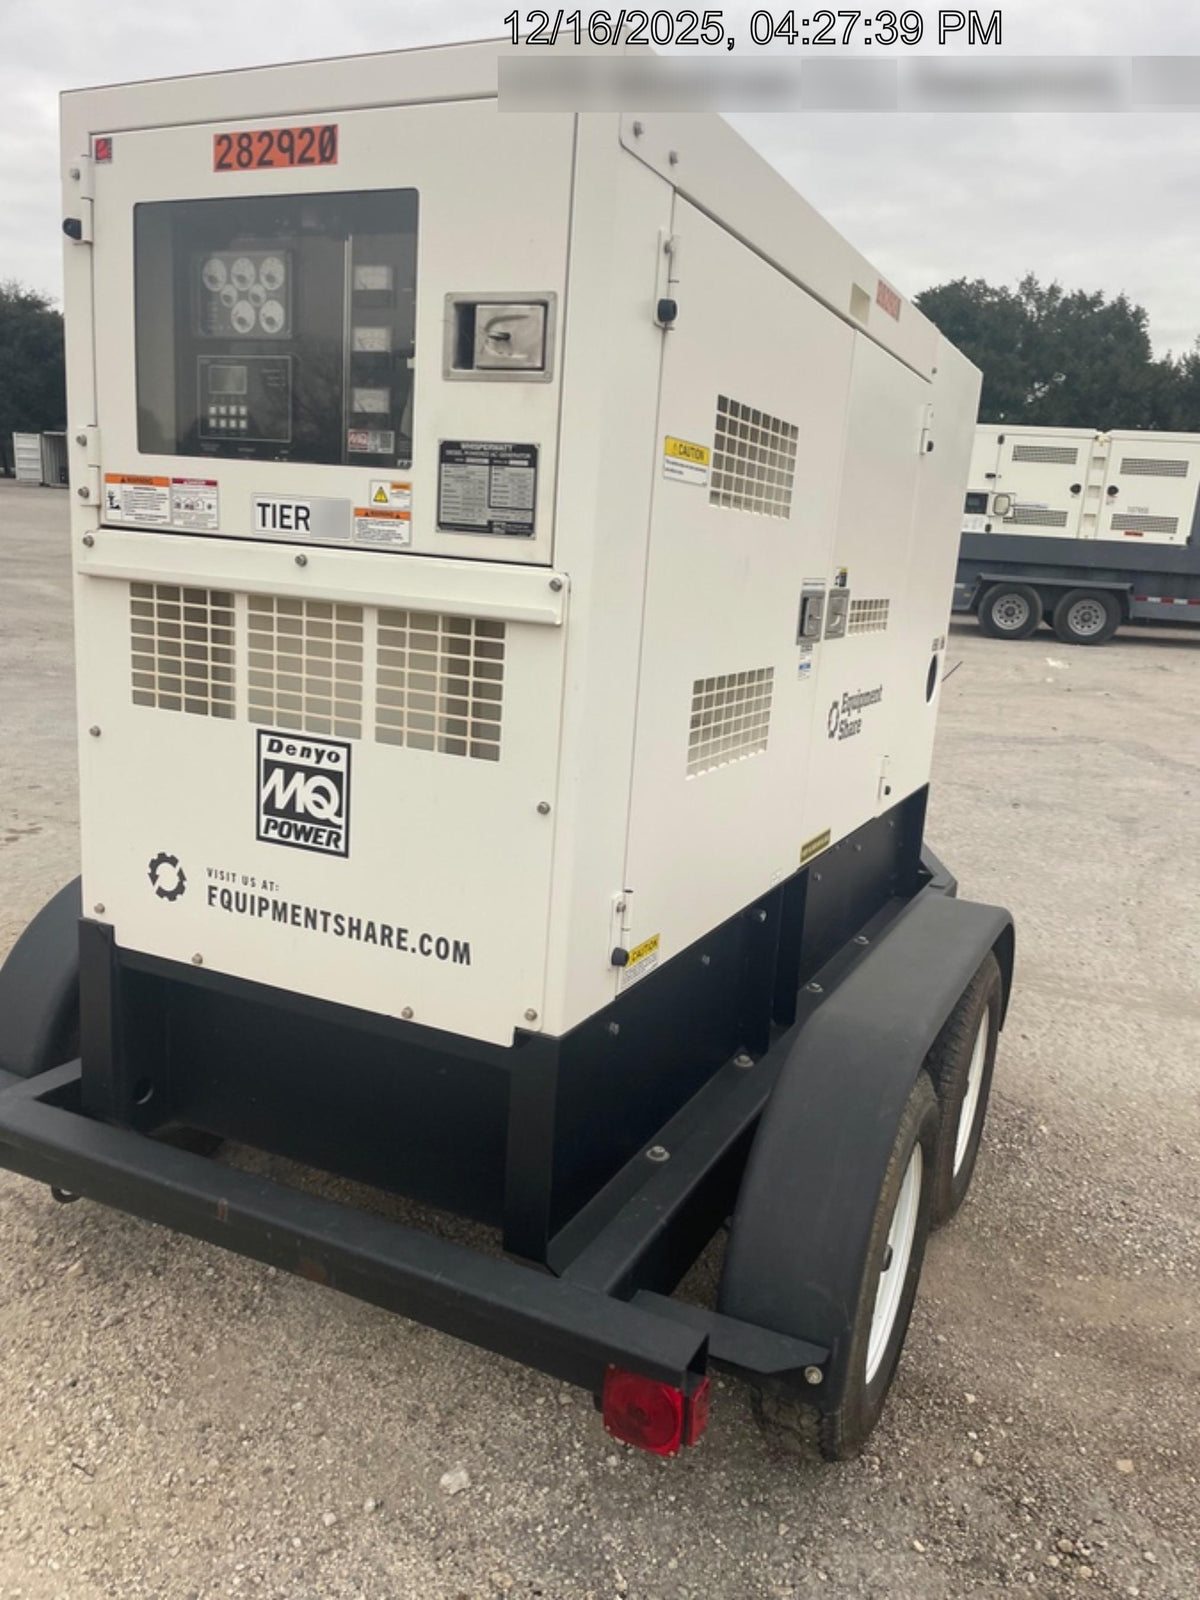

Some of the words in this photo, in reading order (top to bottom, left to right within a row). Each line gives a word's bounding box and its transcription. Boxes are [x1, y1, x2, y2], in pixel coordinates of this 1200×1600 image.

[215, 125, 336, 169] 282920
[256, 502, 311, 531] TIER
[841, 683, 882, 717] Equipment
[838, 717, 862, 741] Share
[267, 738, 341, 765] Denyo
[262, 767, 343, 826] MQ
[263, 817, 342, 849] POWER
[207, 867, 237, 883] VISIT
[242, 875, 256, 888] US
[261, 880, 279, 892] AT:
[207, 884, 471, 966] EQUIPMENTSHARE.COM
